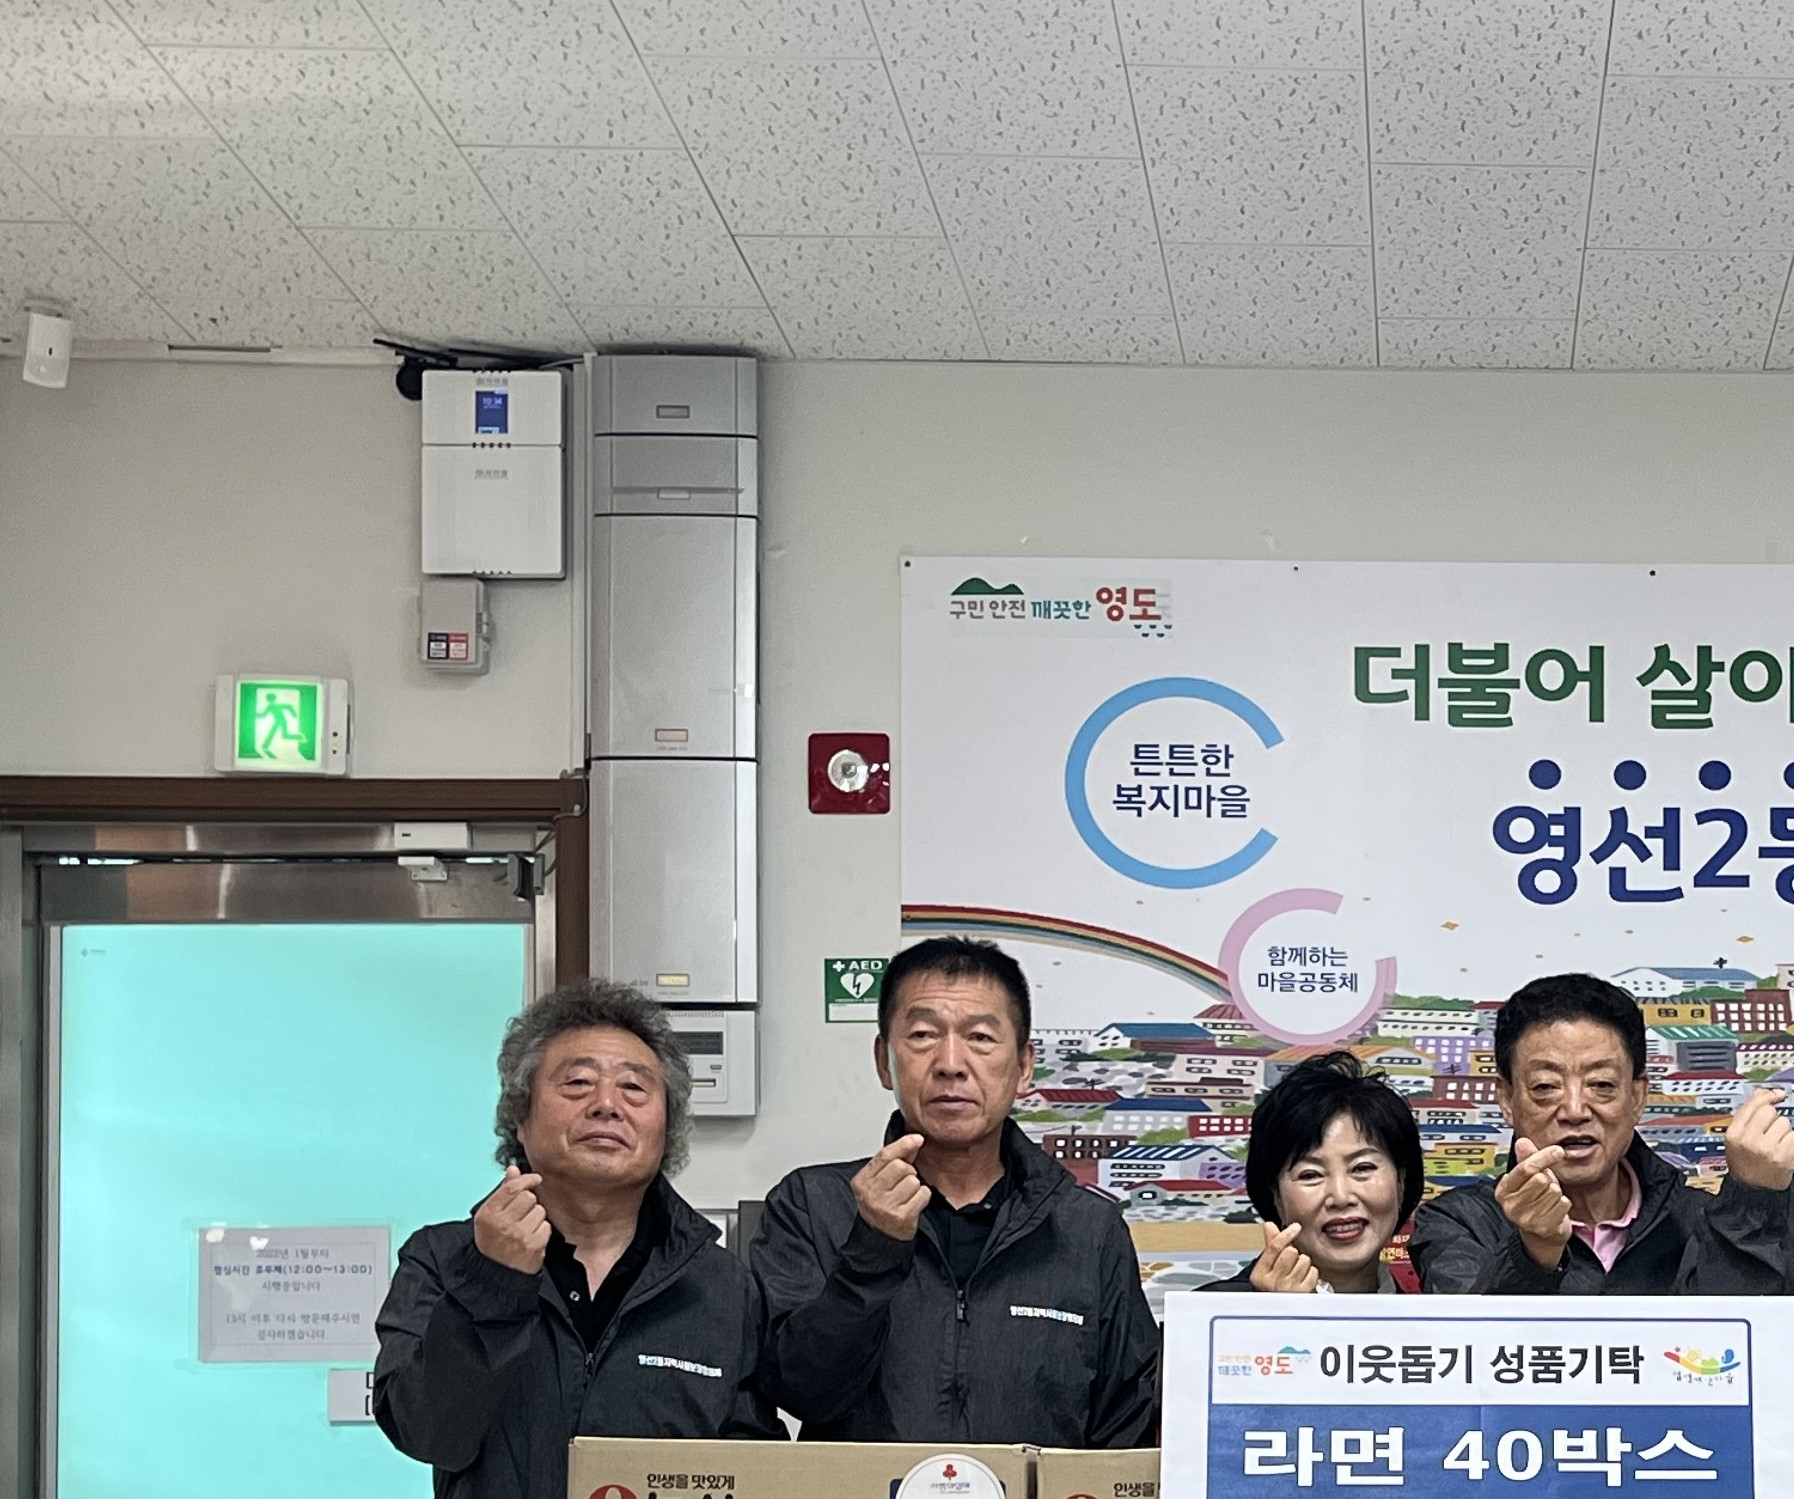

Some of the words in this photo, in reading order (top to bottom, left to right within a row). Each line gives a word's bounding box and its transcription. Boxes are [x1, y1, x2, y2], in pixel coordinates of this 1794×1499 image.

[950, 600, 984, 620] 구민
[989, 600, 1026, 620] 안전
[1031, 600, 1092, 620] 깨끗한
[1096, 587, 1162, 622] 영도
[1353, 642, 1605, 729] 더불어
[1130, 744, 1234, 777] 튼튼한
[1112, 783, 1250, 819] 복지마을
[850, 960, 883, 971] AED
[1267, 945, 1348, 968] 함께하는
[1257, 972, 1358, 995] 마을공동체
[1319, 1343, 1474, 1385] 이웃돕기
[1489, 1343, 1645, 1385] 성품기탁
[1243, 1426, 1405, 1487] 라면
[1443, 1426, 1718, 1487] 40박스
[646, 1474, 688, 1489] 인생을
[692, 1474, 735, 1490] 맛있게
[1114, 1482, 1155, 1497] 인생을
